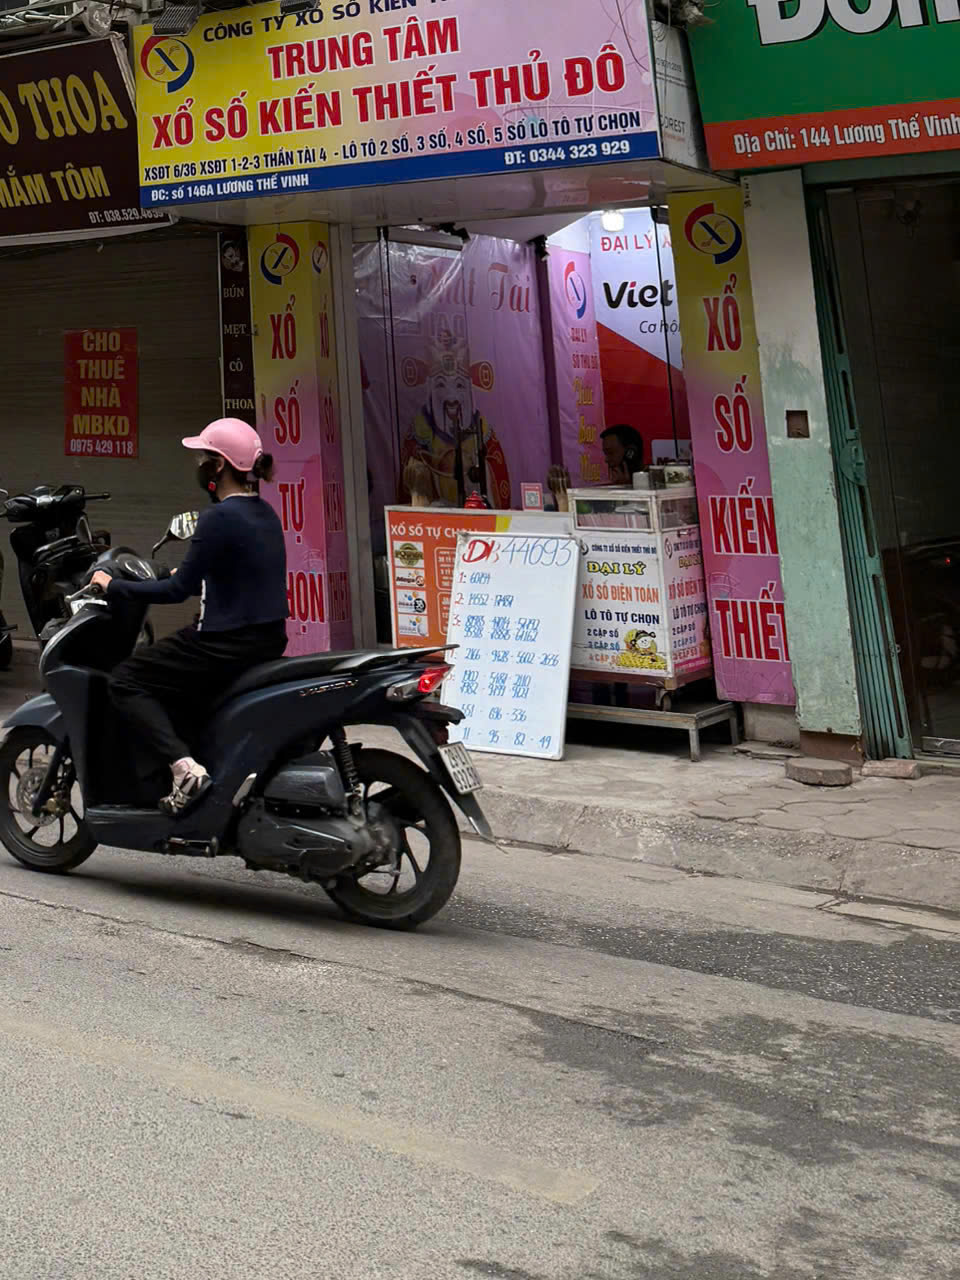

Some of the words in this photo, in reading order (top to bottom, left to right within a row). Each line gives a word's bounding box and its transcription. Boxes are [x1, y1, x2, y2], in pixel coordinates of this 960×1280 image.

[203, 18, 254, 43] CÔNG
[261, 15, 285, 33] TY
[267, 28, 374, 81] TRUNG
[382, 15, 460, 58] TÂM
[18, 70, 129, 142] THOA
[151, 98, 195, 151] XỔ
[204, 91, 248, 143] SỐ
[258, 81, 343, 137] KIẾN
[352, 64, 458, 123] THIẾT
[469, 49, 550, 107] THỦ
[563, 42, 626, 97] ĐÔ
[173, 163, 198, 179] 6/36
[230, 155, 261, 173] 1-2-3
[295, 146, 316, 166] TÀI
[319, 148, 328, 163] 4
[341, 139, 359, 160] LÔ
[360, 137, 379, 158] TÔ
[380, 139, 389, 155] 2
[416, 135, 425, 150] 3
[454, 130, 464, 146] 4
[493, 126, 504, 142] 5
[506, 116, 527, 140] SỐ
[530, 117, 548, 138] LÔ
[550, 114, 571, 136] TÔ
[572, 114, 595, 138] TỰ
[596, 109, 640, 133] CHỌN
[734, 130, 763, 155] Địa
[800, 125, 831, 148] 144
[833, 119, 884, 147] Lương
[887, 110, 921, 141] Thế
[924, 109, 960, 137] Vinh
[504, 149, 525, 166] ĐT:
[528, 145, 564, 164] 0344
[568, 142, 598, 160] 323
[601, 139, 631, 157] 929
[51, 161, 112, 202] TÔM
[186, 181, 215, 197] 146A
[216, 176, 254, 195] LƯƠNG
[255, 171, 277, 192] THẾ
[279, 173, 309, 190] VINH
[601, 234, 629, 255] ĐẠI
[633, 229, 654, 250] LÝ
[223, 284, 245, 298] BÚN
[603, 280, 675, 310] Viet
[703, 273, 742, 353] XỔ
[82, 331, 121, 352] CHO
[270, 295, 297, 361] XỔ
[77, 355, 125, 380] THUÊ
[81, 382, 121, 408] NHÀ
[225, 398, 255, 409] THOA
[72, 414, 129, 436] MBKD
[274, 380, 302, 445] SỐ
[714, 376, 754, 454] SỐ
[70, 438, 93, 453] 0975
[95, 439, 113, 454] 429
[115, 440, 133, 455] 118
[278, 478, 306, 544] TỰ
[708, 476, 779, 556] KIẾN
[391, 521, 406, 536] XỔ
[408, 522, 424, 537] SỐ
[426, 526, 441, 539] TỰ
[501, 537, 572, 567] 44693
[587, 561, 621, 576] ĐẠI
[622, 560, 646, 575] LÝ
[582, 579, 594, 600] XỔ
[596, 580, 609, 600] SỐ
[610, 582, 632, 604] ĐIỆN
[634, 583, 659, 604] TOÁN
[585, 608, 597, 620] LÔ
[600, 609, 613, 621] TÔ
[615, 611, 628, 625] TỰ
[630, 612, 660, 626] CHỌN
[609, 627, 619, 638] SỐ
